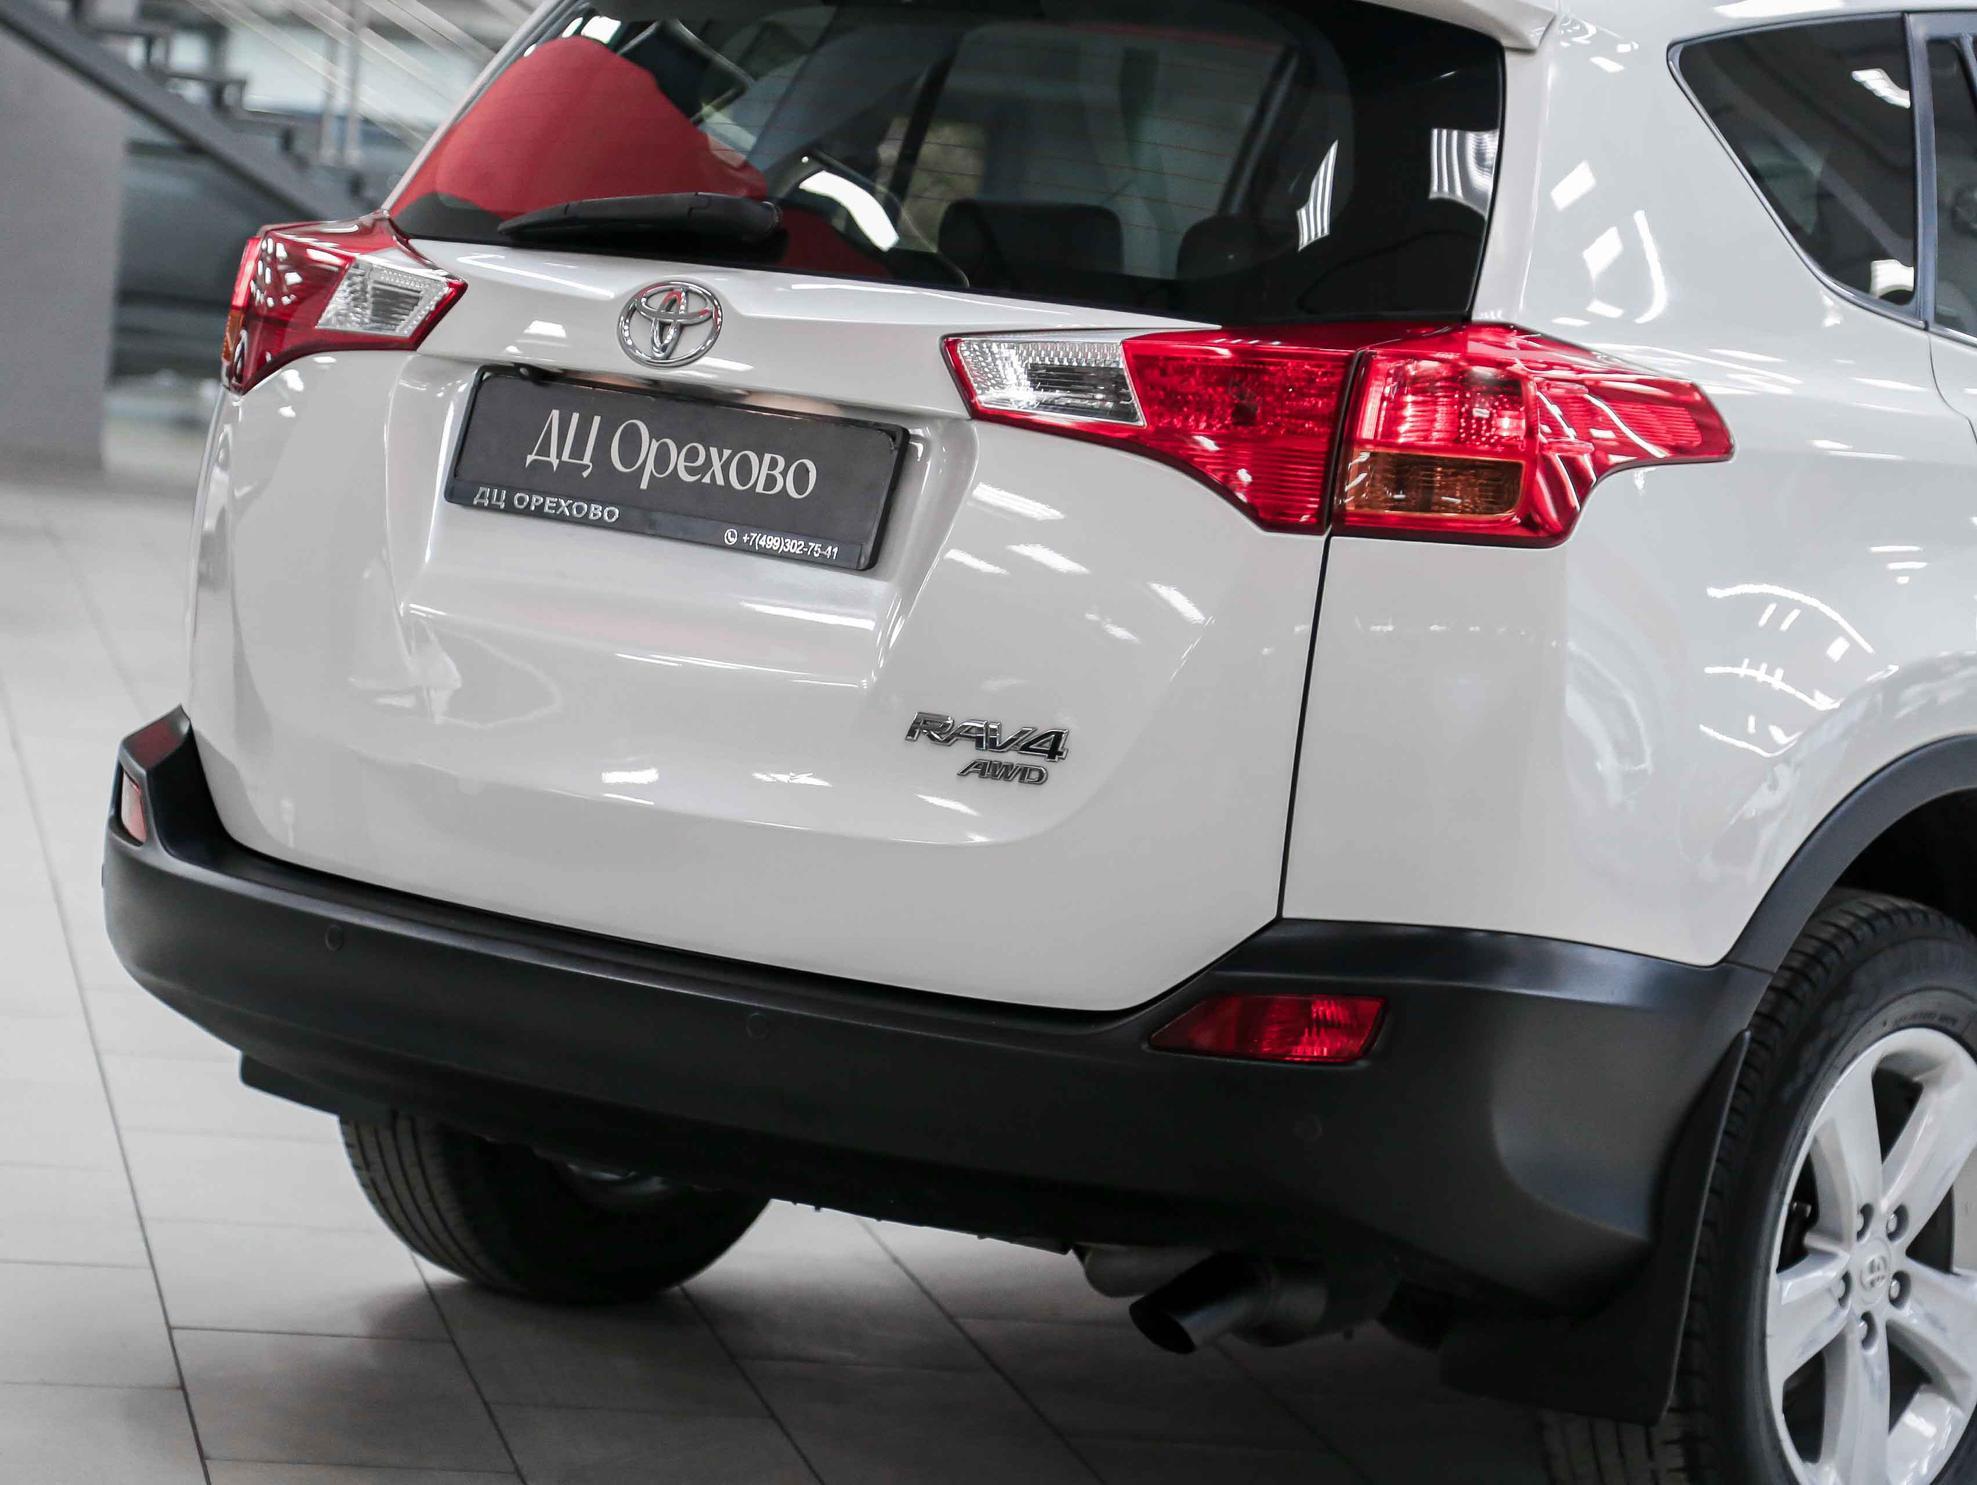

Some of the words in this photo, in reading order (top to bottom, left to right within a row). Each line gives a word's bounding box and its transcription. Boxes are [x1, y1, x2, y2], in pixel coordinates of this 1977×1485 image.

[526, 409, 602, 478] ДЦ
[610, 419, 817, 500] Орехово
[473, 487, 507, 509] ДЦ
[514, 492, 620, 523] ОРЕХОВО
[742, 532, 839, 560] +7(499)302-75-41
[905, 712, 1070, 762] RAV4
[957, 759, 1049, 785] AWD
